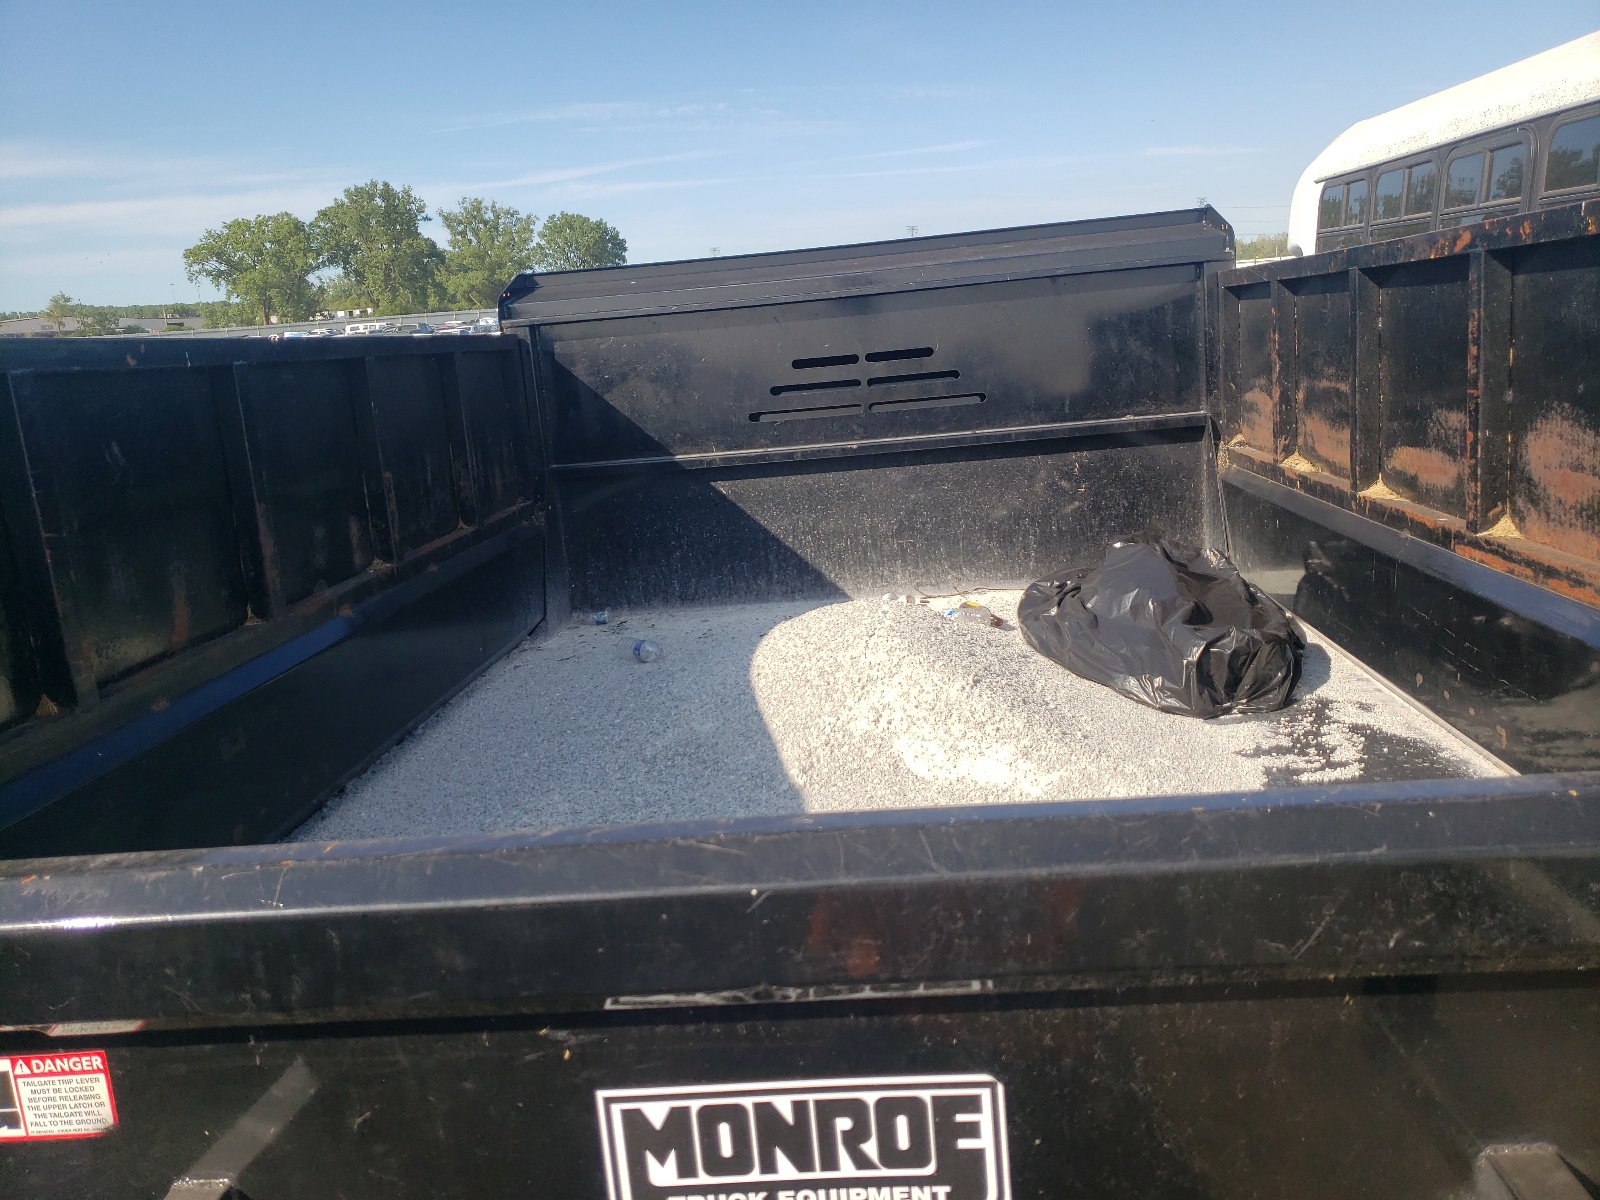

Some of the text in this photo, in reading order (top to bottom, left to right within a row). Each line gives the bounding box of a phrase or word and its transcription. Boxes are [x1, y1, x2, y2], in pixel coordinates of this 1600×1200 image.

[31, 1055, 104, 1074] DANGER
[22, 1079, 57, 1087] TAILGATE
[27, 1094, 101, 1104] BEFORE RELEASING
[48, 1111, 83, 1119] TAILGATE
[620, 1093, 983, 1179] MONROE
[777, 1185, 953, 1200] EQUIPMENT
